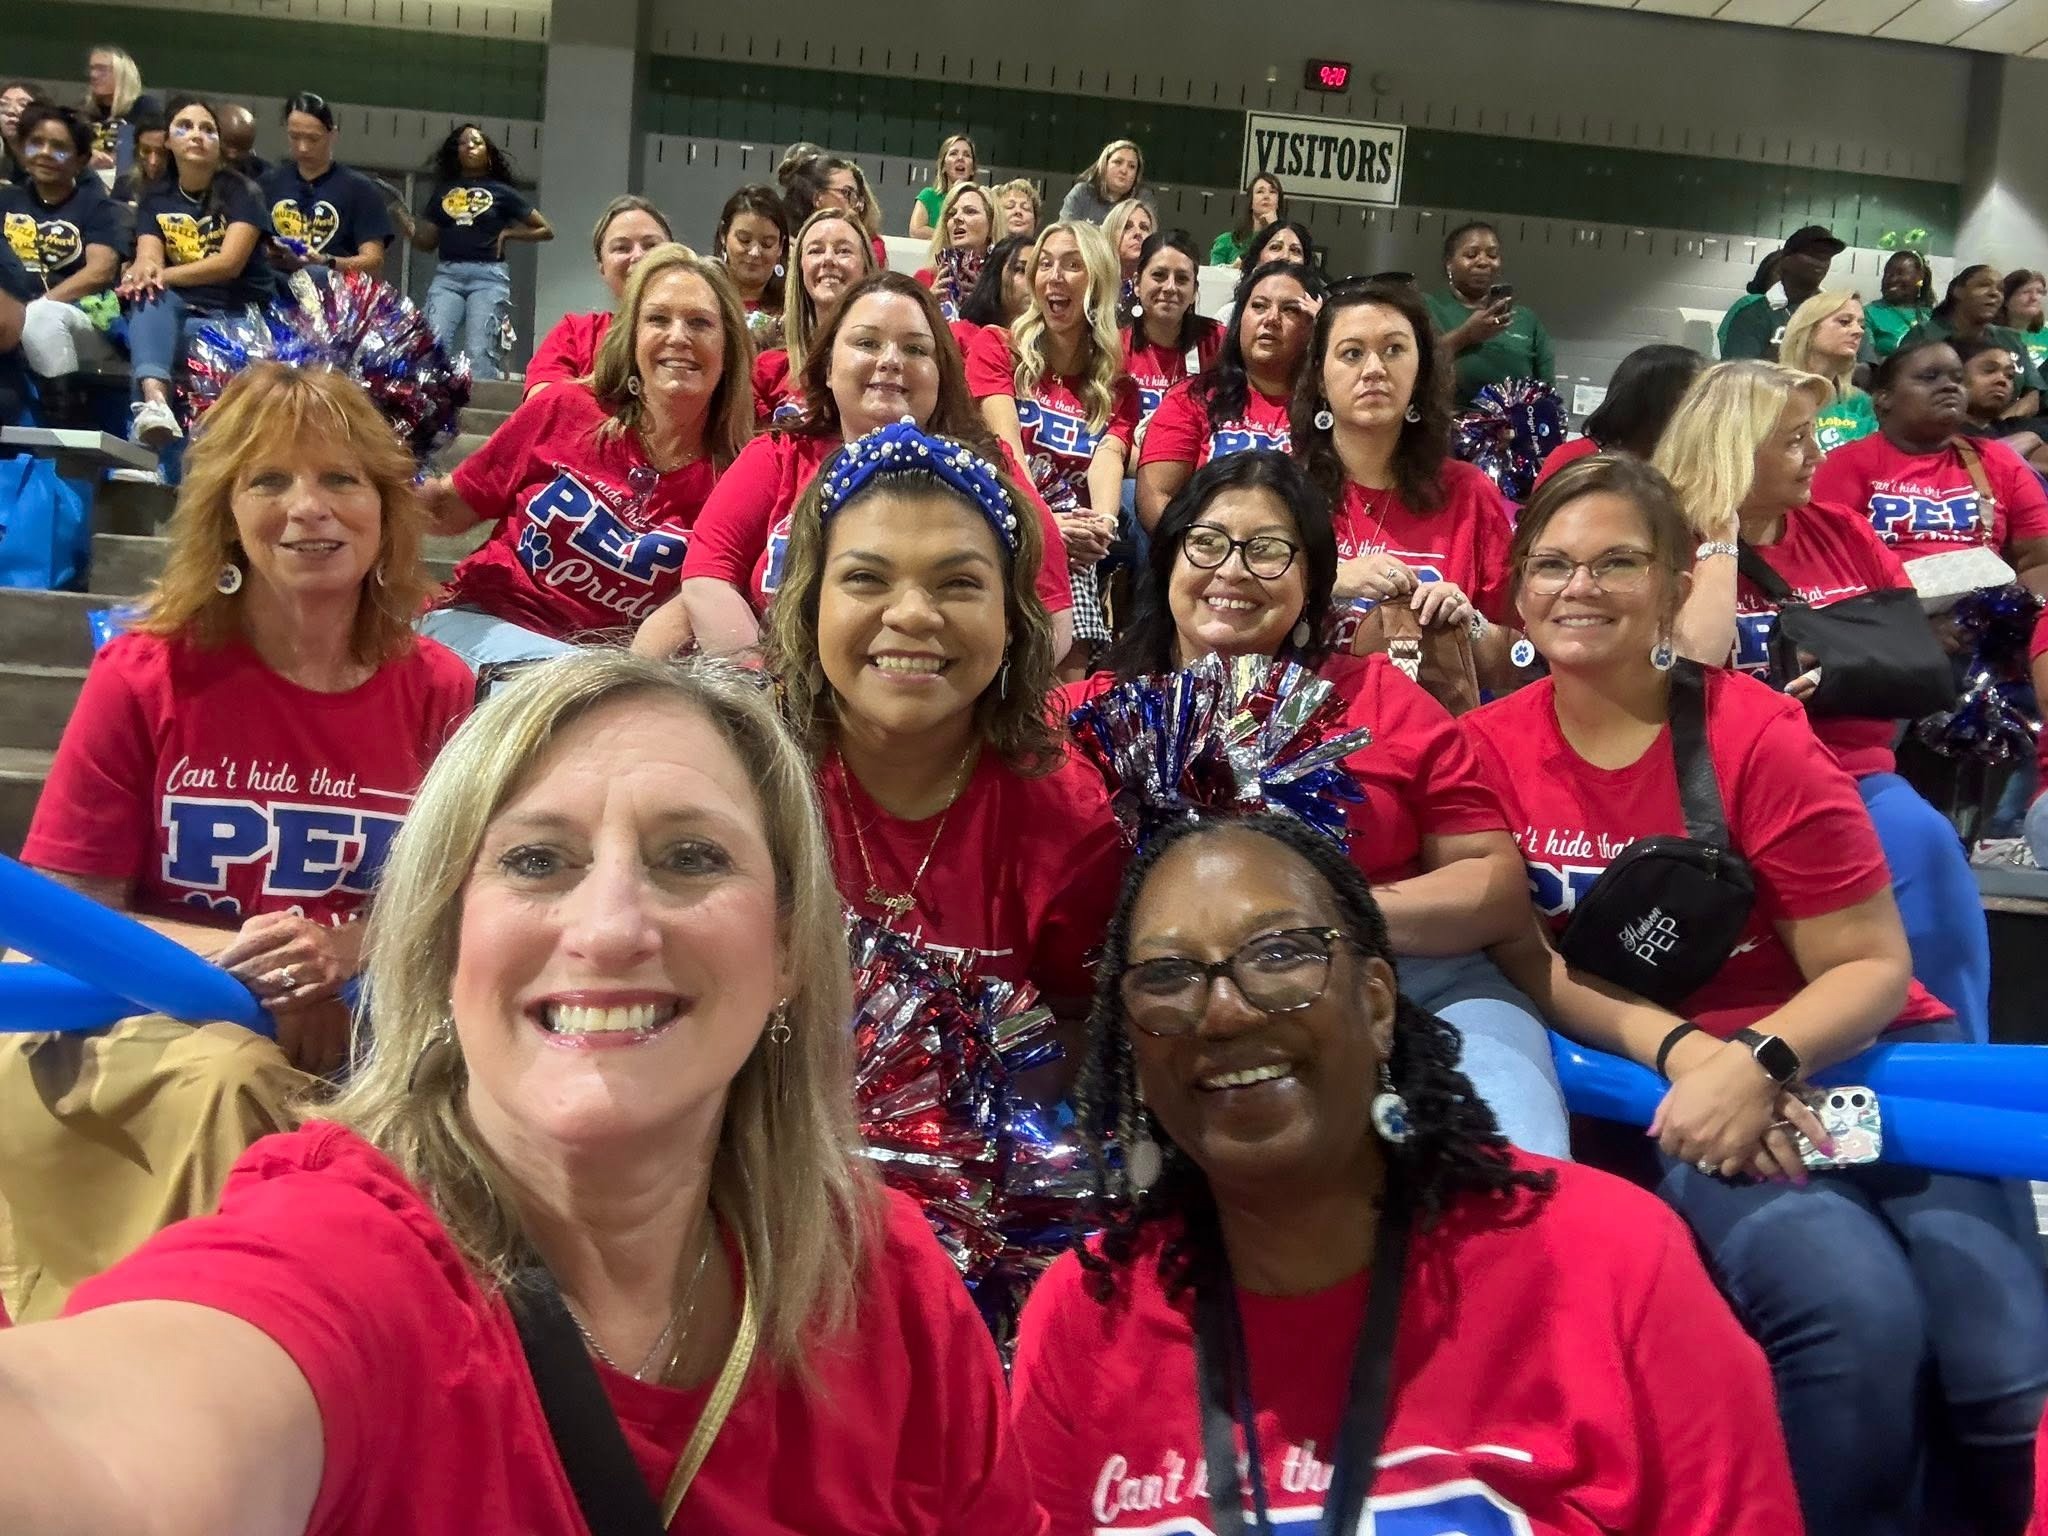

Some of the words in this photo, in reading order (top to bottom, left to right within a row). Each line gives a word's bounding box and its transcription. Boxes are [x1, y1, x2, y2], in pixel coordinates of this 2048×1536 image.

[1255, 129, 1393, 185] VISITORS
[1055, 401, 1076, 414] that
[1336, 537, 1353, 557] ide
[166, 755, 237, 793] Can't
[247, 761, 299, 794] hide
[309, 767, 357, 799] that
[1544, 828, 1594, 859] hide
[1618, 905, 1663, 953] Hudson
[1635, 916, 1681, 967] PEP
[1094, 1449, 1184, 1524] Can't
